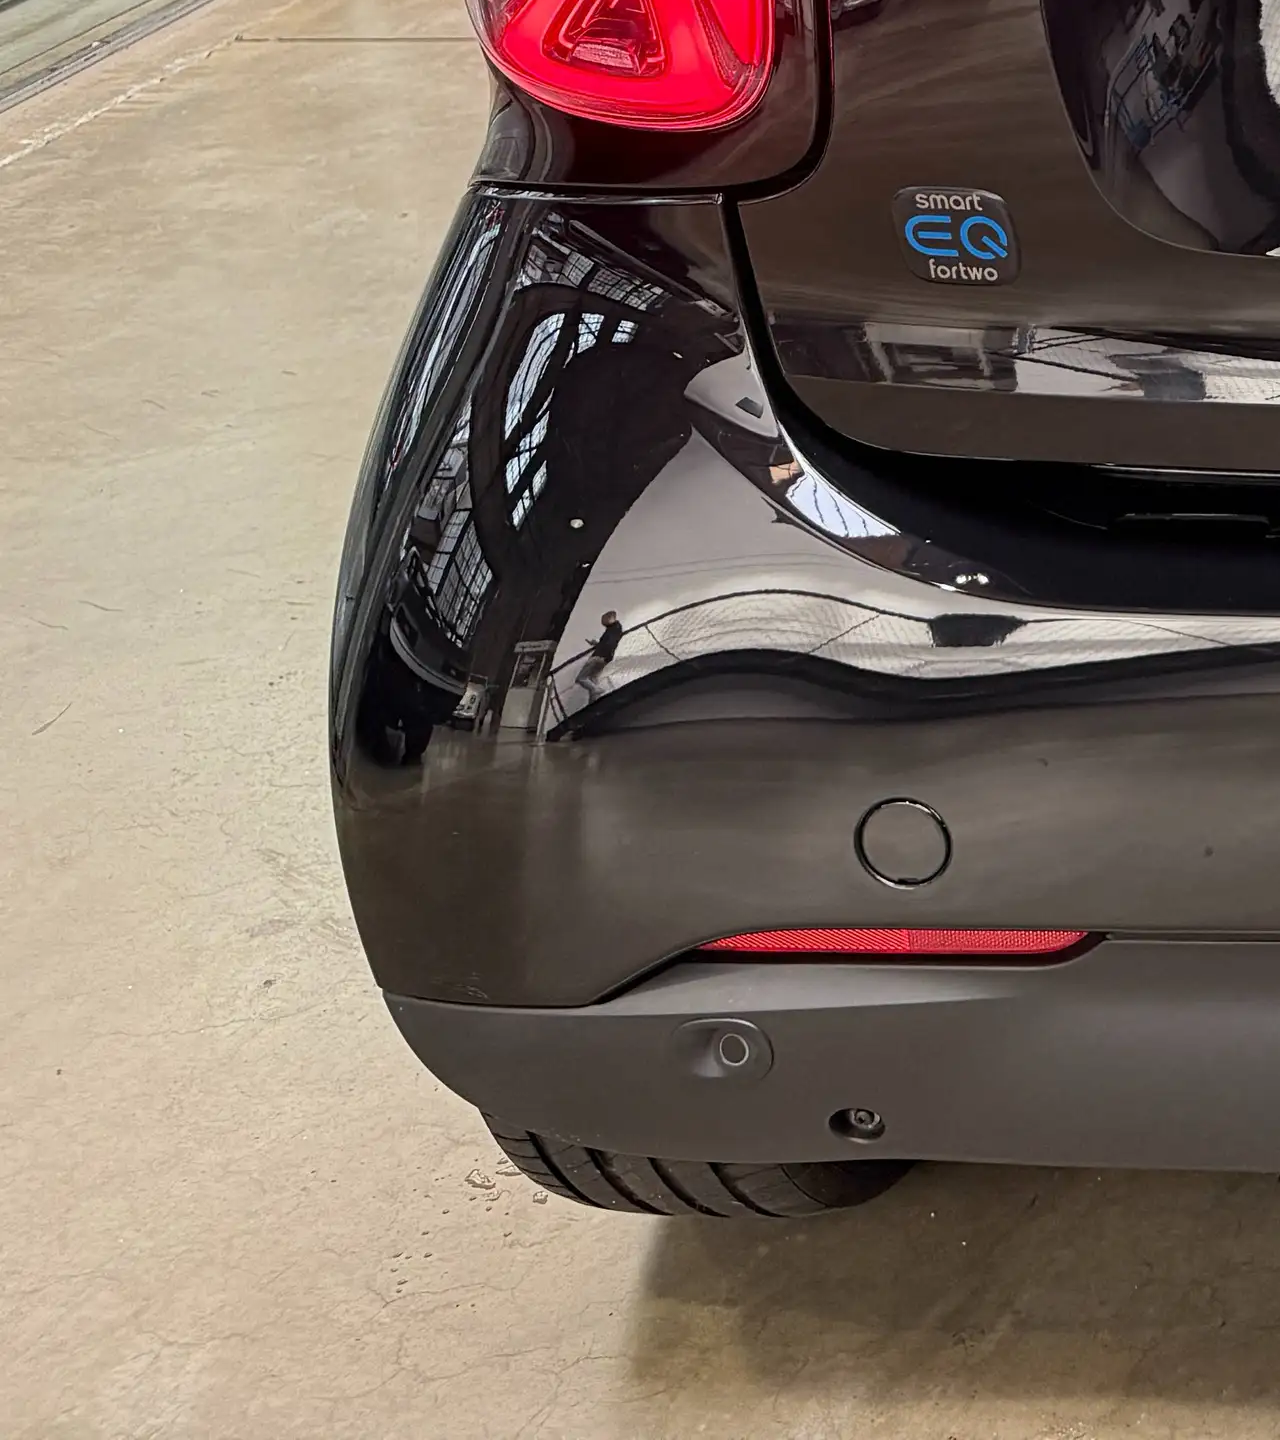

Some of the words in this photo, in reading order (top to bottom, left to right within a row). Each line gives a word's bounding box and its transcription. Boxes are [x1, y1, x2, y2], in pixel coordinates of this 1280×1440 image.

[915, 192, 983, 211] smart
[904, 214, 1009, 260] EQ
[928, 258, 999, 282] fortwo
